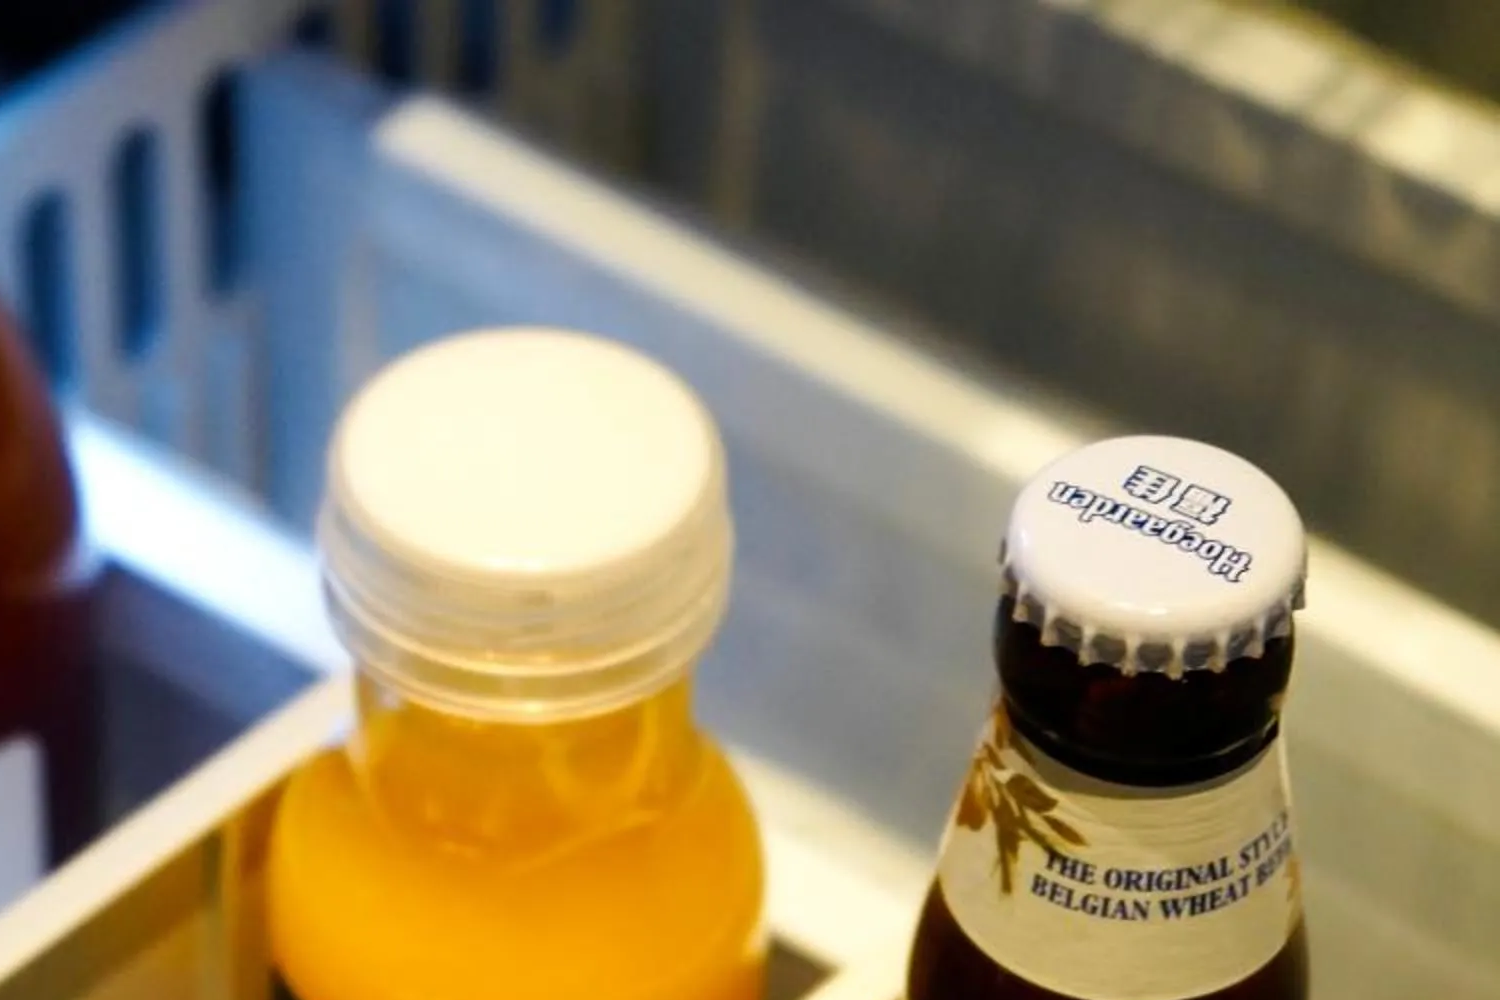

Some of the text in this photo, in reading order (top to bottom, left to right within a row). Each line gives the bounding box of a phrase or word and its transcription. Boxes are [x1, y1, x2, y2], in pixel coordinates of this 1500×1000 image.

[1122, 465, 1232, 526] 福佳
[1048, 481, 1253, 583] Hoegaarden
[1031, 873, 1151, 921] BELGIAN
[1159, 875, 1251, 920] WHEAT
[1044, 850, 1096, 886] THE
[1104, 855, 1234, 893] ORIGINAL
